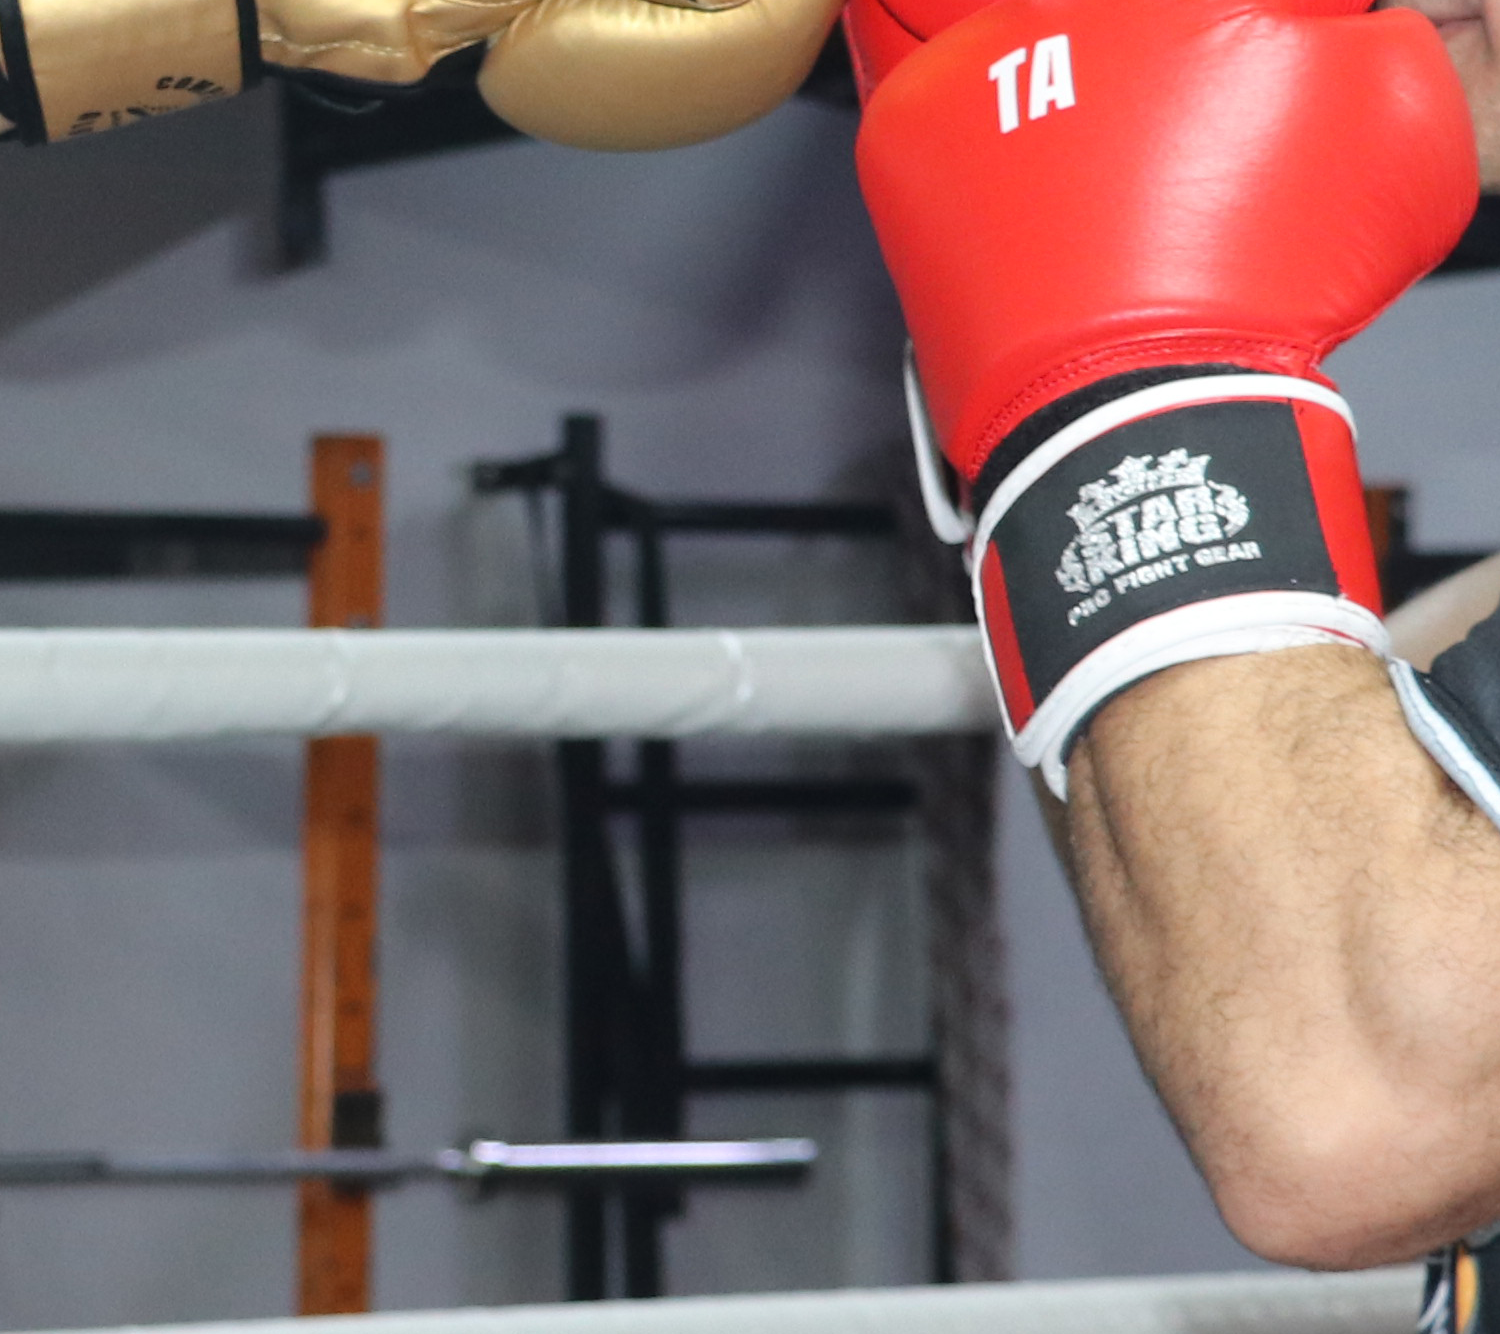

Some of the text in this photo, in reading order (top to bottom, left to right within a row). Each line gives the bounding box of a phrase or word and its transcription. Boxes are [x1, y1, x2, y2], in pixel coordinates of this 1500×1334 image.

[986, 33, 1077, 135] TA
[1081, 514, 1223, 586] KING
[1113, 553, 1190, 595] FIGHT
[1193, 541, 1263, 568] GEAR
